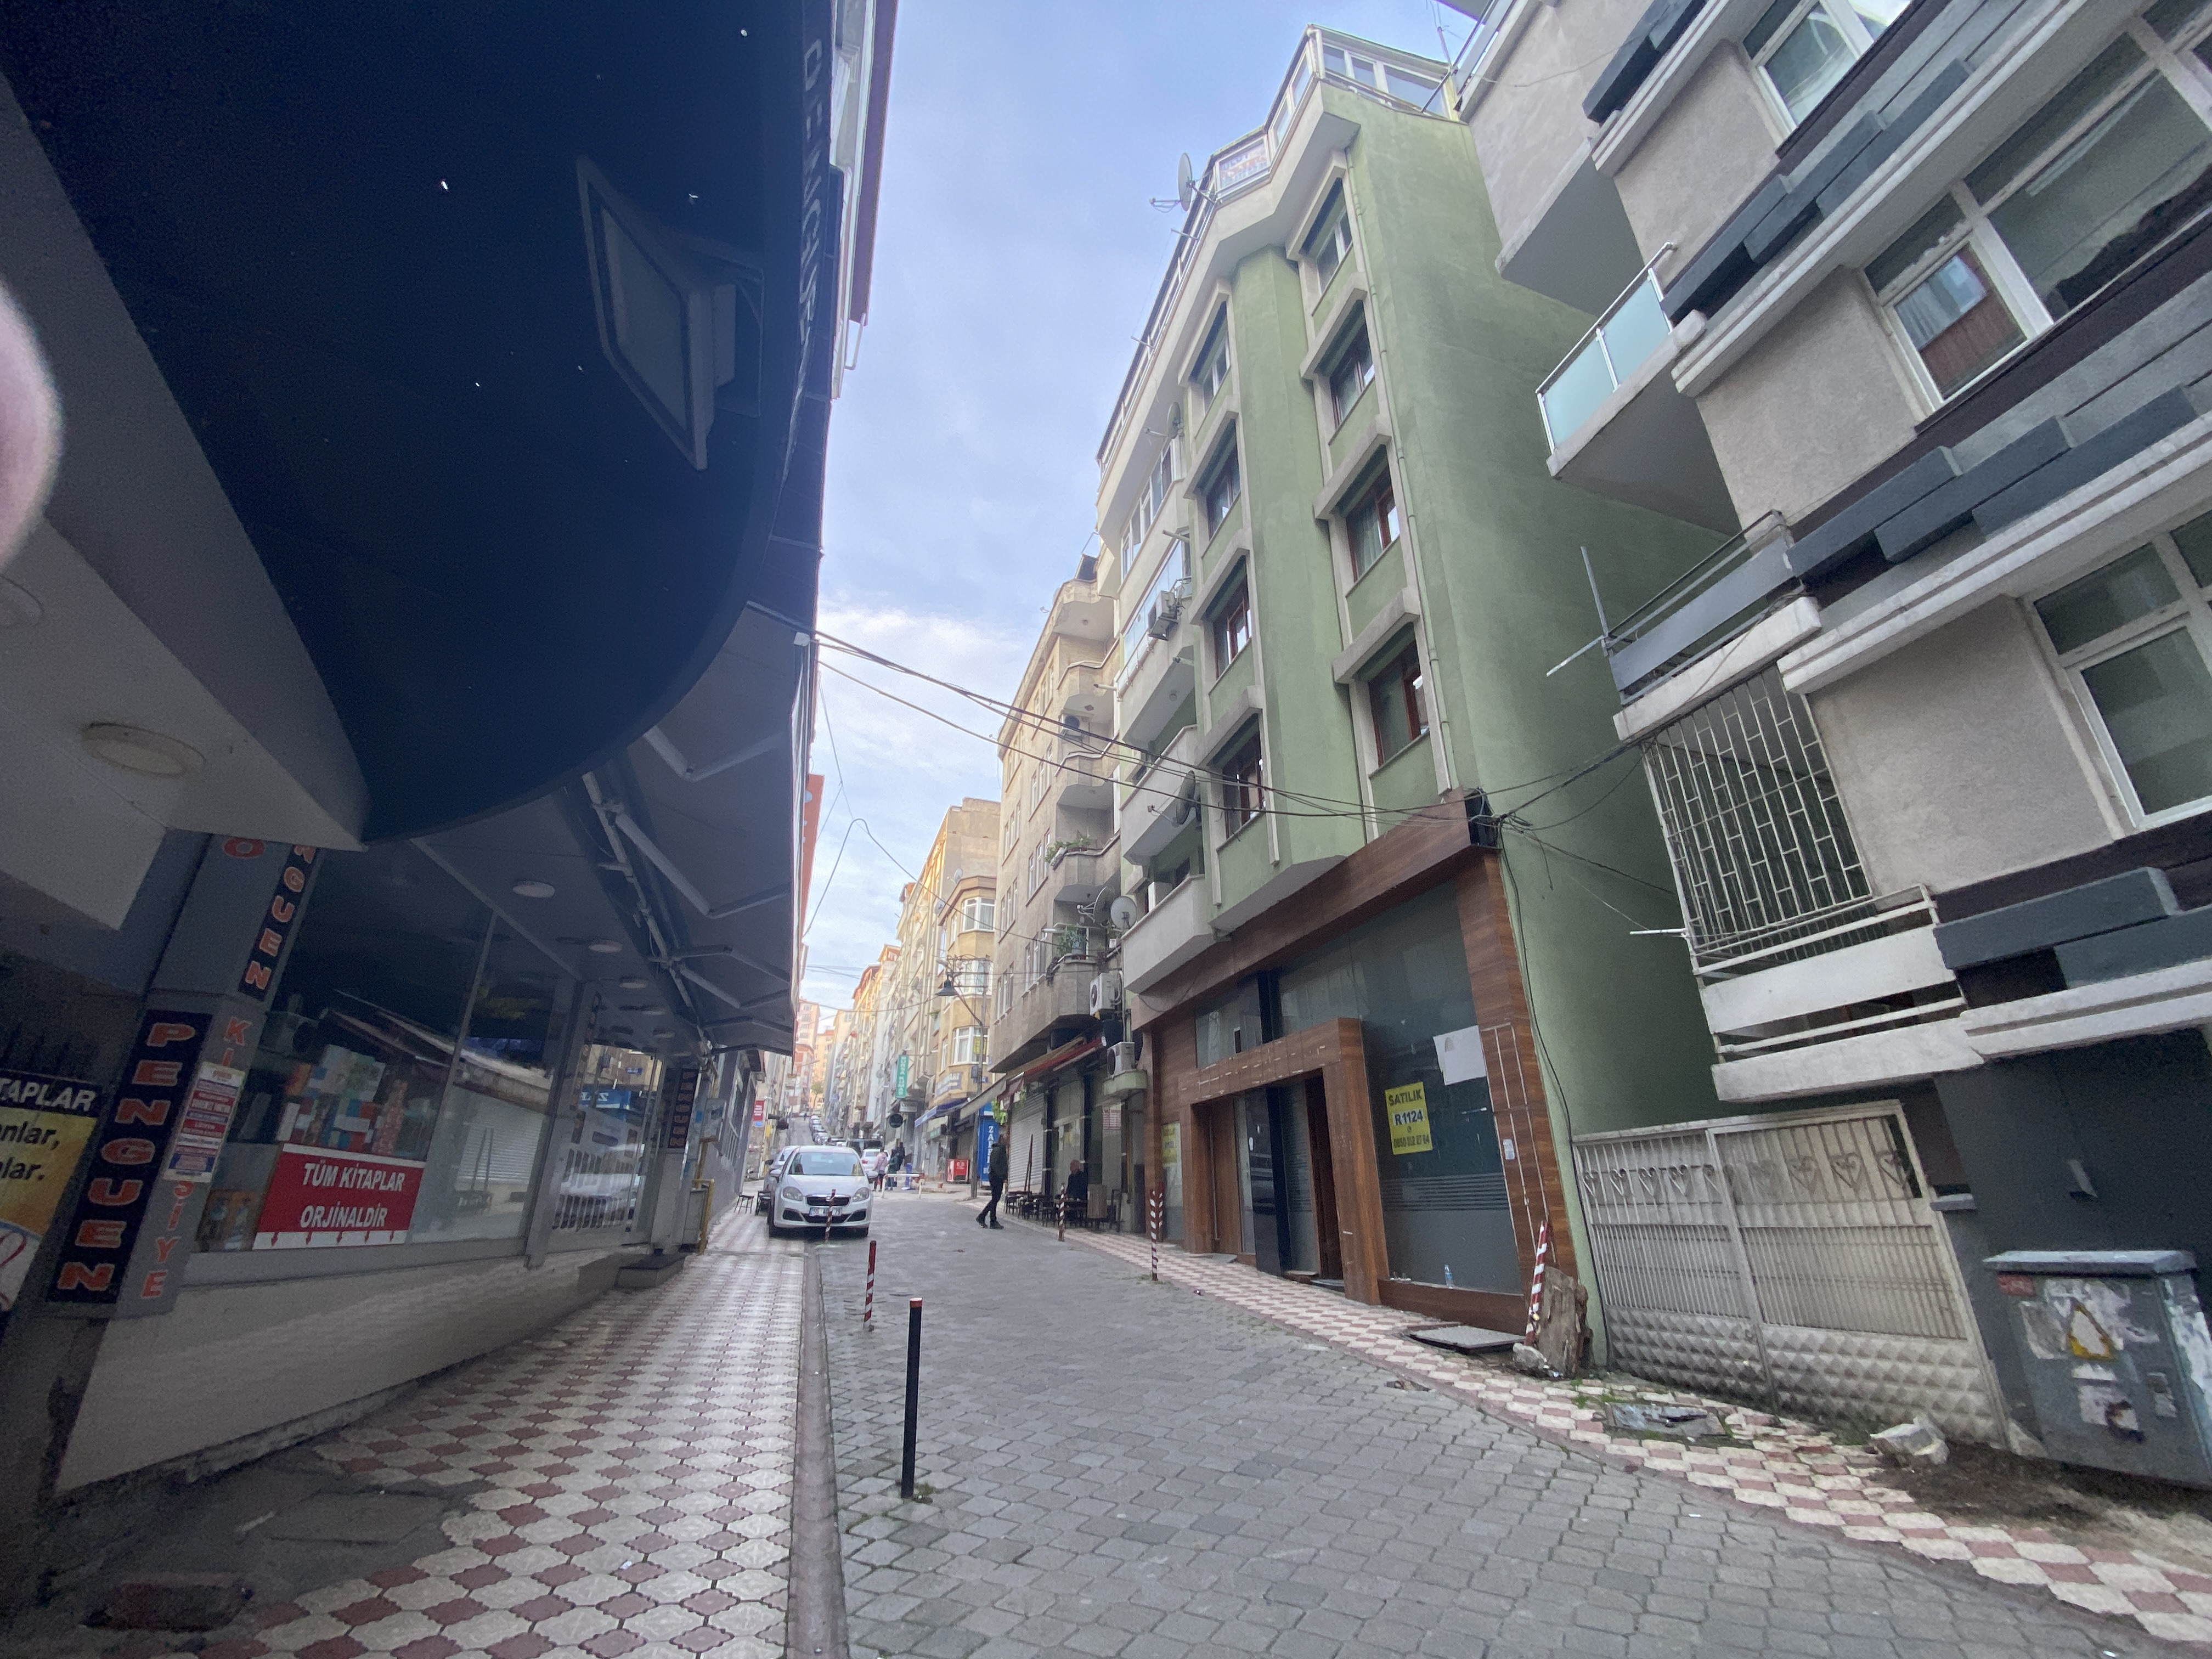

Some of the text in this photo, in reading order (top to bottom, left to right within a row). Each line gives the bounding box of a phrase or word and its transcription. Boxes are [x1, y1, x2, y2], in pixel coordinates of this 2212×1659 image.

[670, 1071, 696, 1147] PENGUEN
[1388, 1089, 1423, 1105] SATILIK
[1395, 1109, 1423, 1126] R1124
[0, 1121, 60, 1151] nlar,
[57, 1022, 196, 1291] PENGUEN
[302, 1159, 405, 1192] TÜM KİTAPLAR
[300, 1200, 388, 1228] ORJİNALDİR
